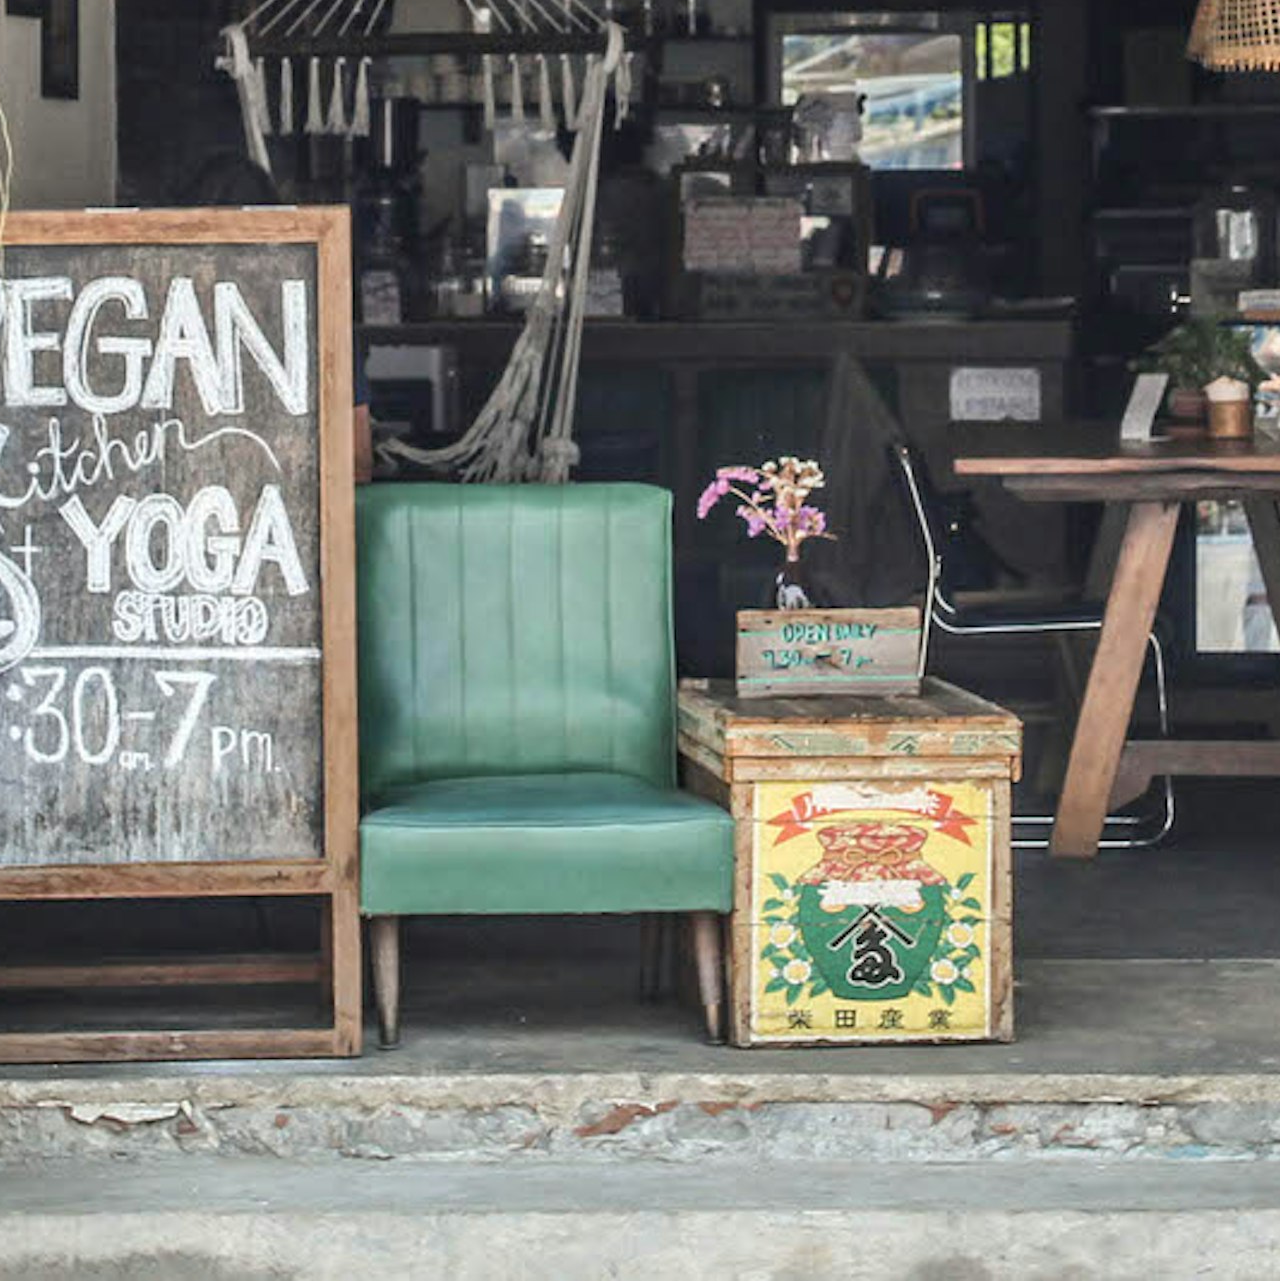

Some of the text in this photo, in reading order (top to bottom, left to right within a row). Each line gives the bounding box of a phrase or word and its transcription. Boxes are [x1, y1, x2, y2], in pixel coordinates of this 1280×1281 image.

[58, 484, 310, 596] YOGA
[112, 591, 269, 644] STUDIO
[781, 623, 831, 644] OPEN
